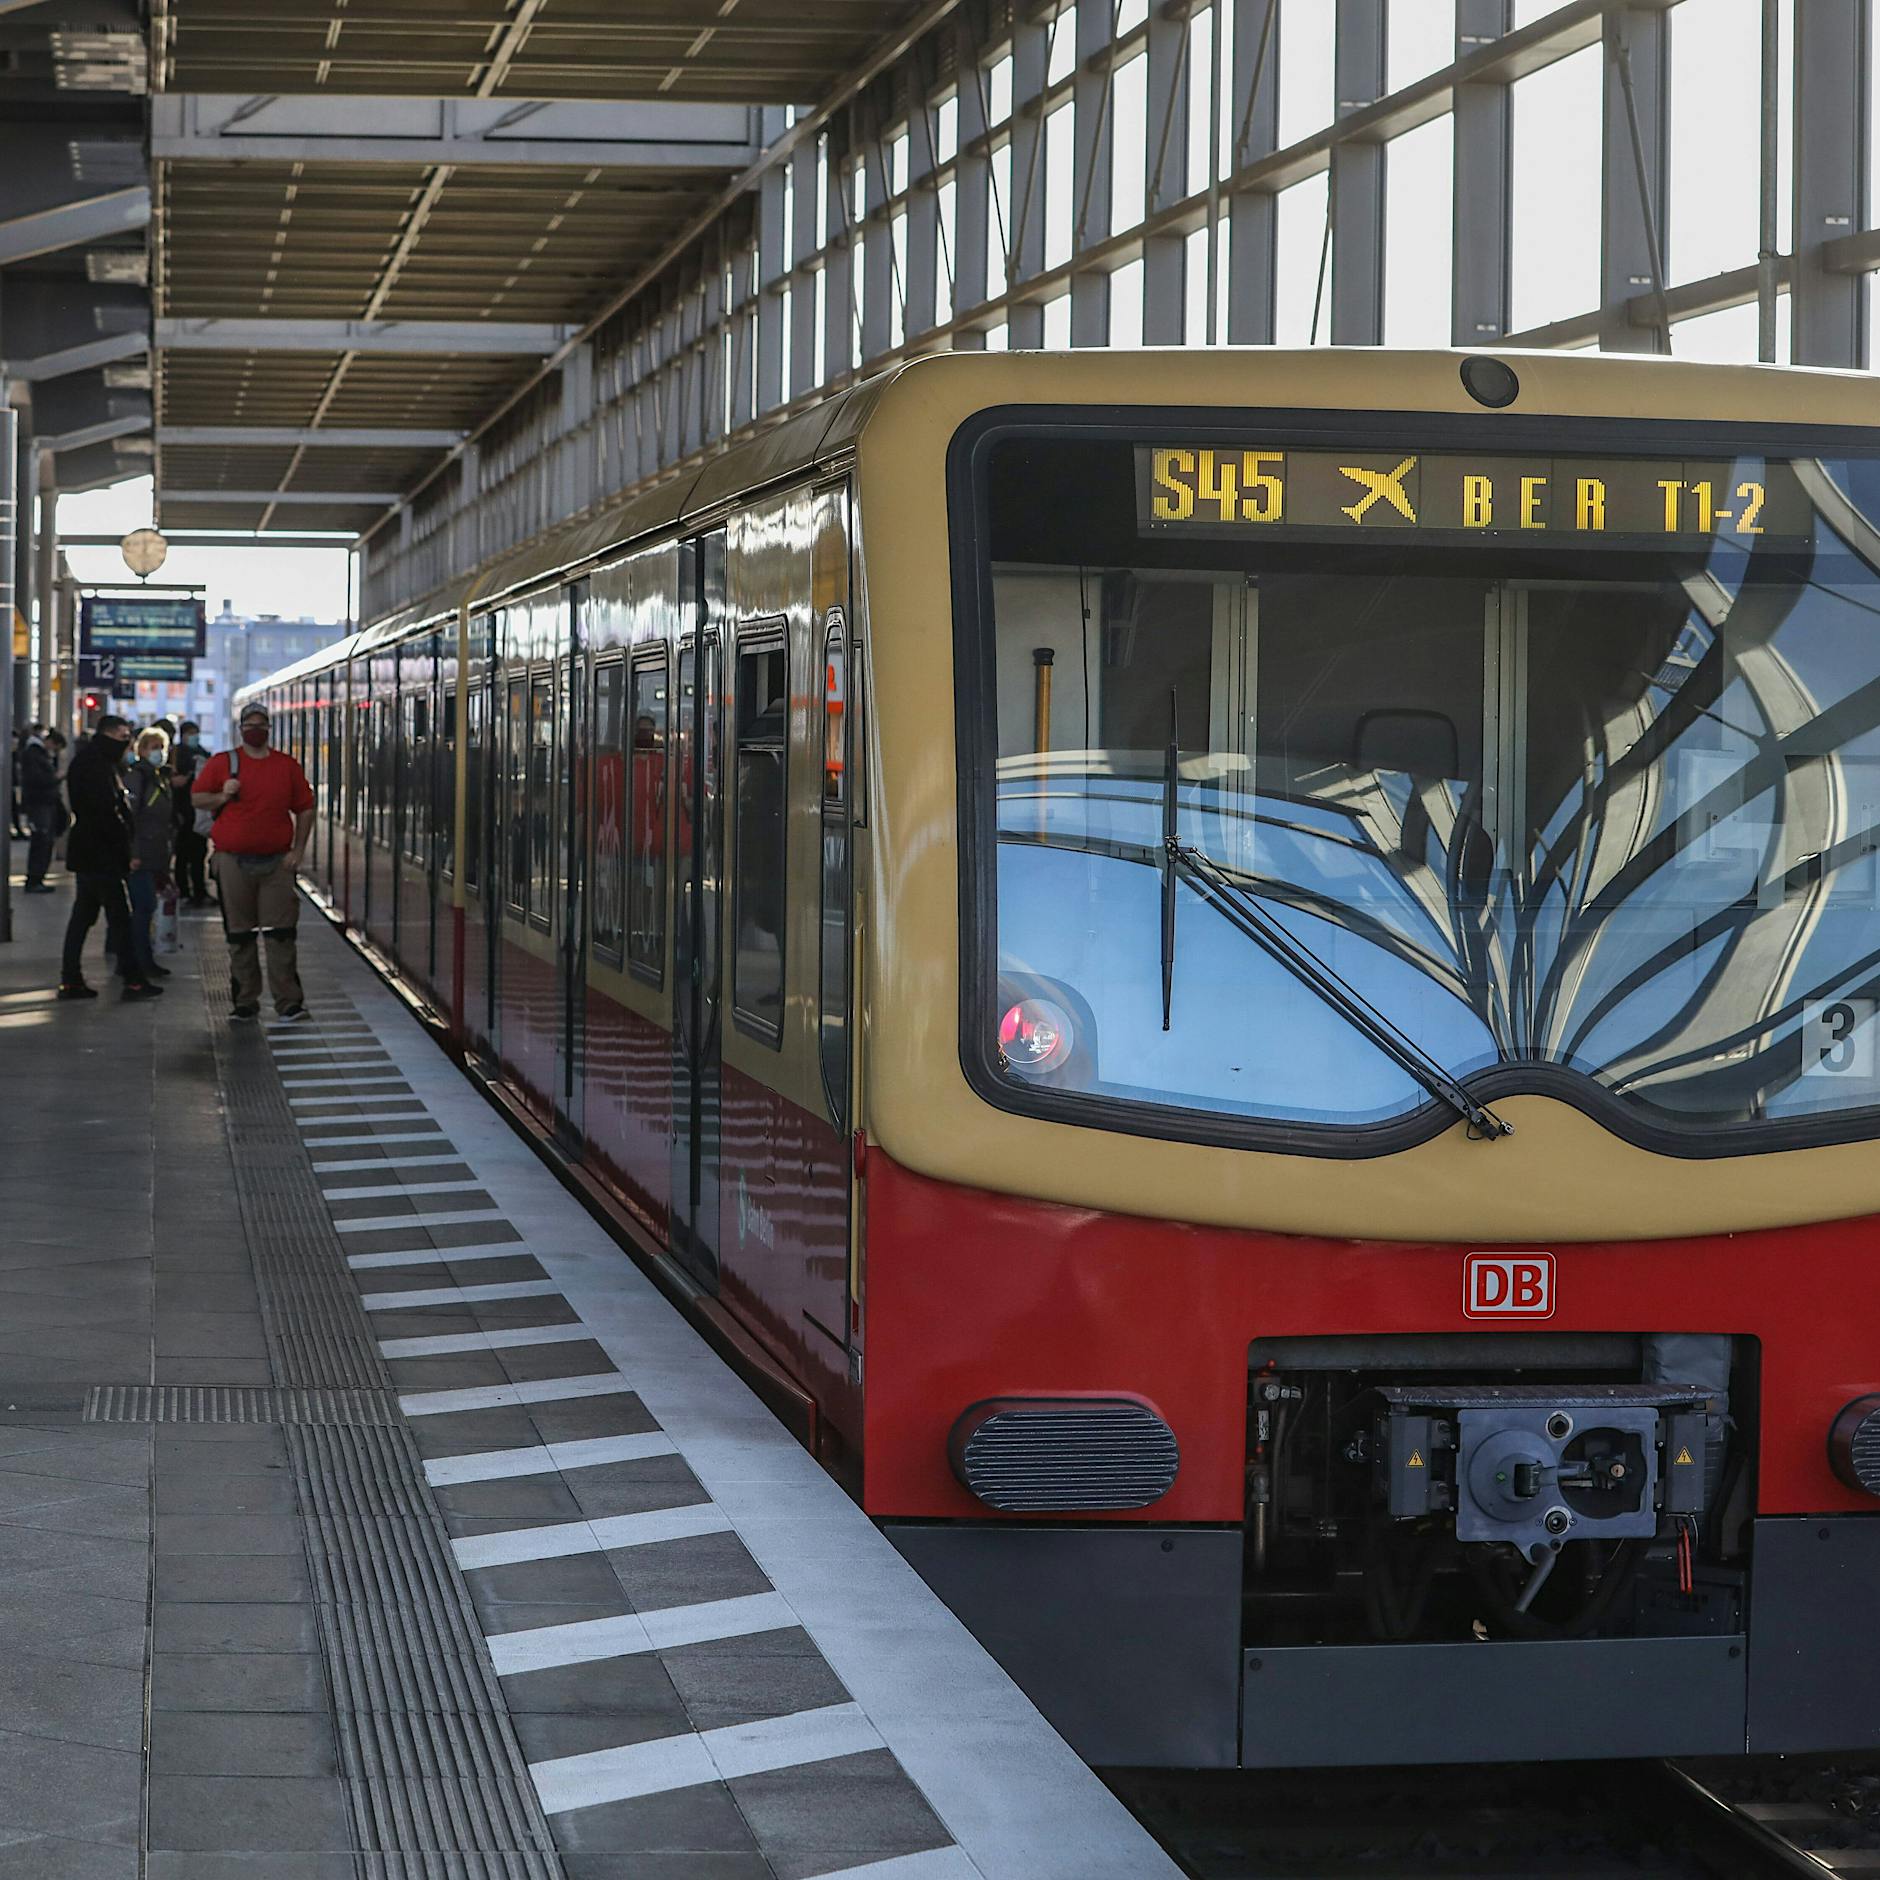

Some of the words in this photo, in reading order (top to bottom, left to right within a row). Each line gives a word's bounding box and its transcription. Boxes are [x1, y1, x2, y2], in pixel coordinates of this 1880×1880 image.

[1154, 451, 1283, 522] S45
[1658, 481, 1765, 533] T1-2
[91, 660, 115, 679] 12
[1820, 1003, 1855, 1073] 3
[1476, 1264, 1544, 1307] DB
